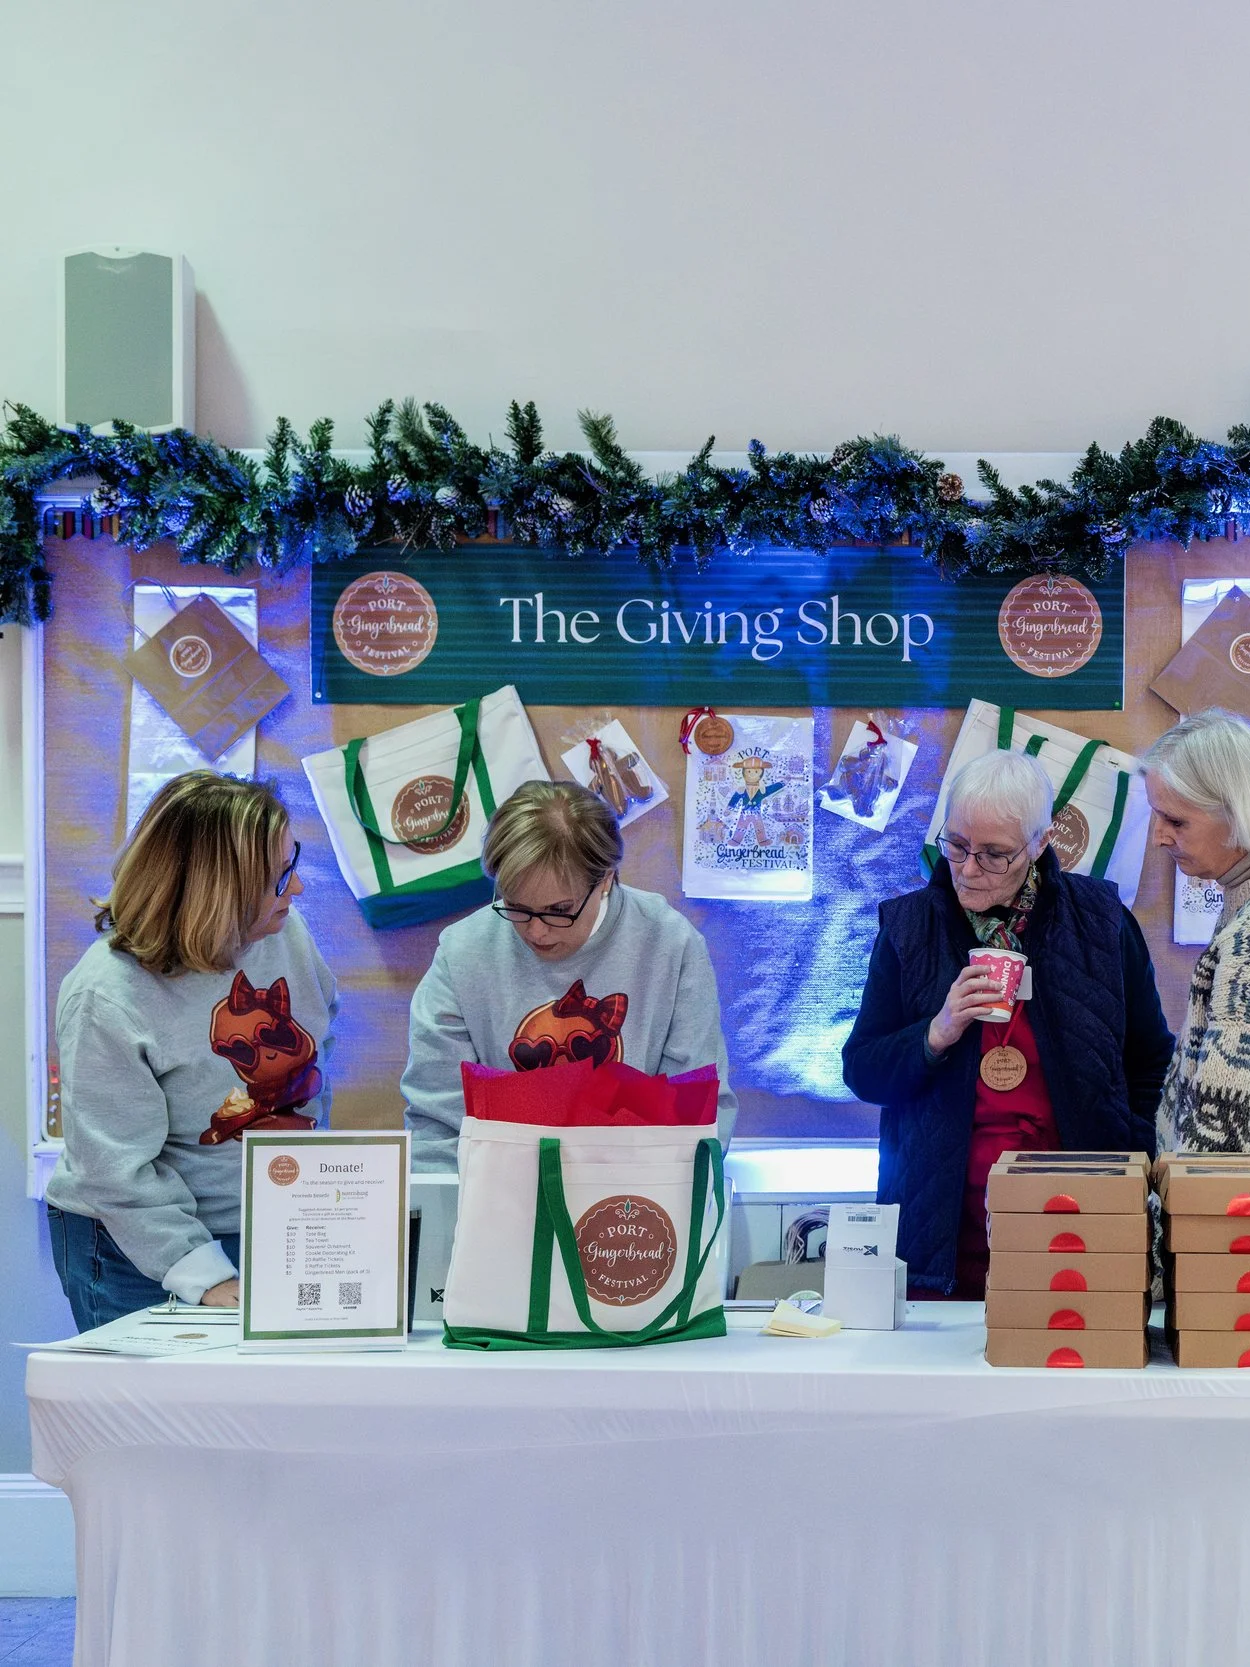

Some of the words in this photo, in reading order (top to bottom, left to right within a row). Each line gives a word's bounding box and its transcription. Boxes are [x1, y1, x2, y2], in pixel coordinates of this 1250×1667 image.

[368, 599, 407, 612] PORT
[1032, 600, 1071, 613] PORT
[346, 614, 425, 640] Gingerbread
[500, 592, 600, 644] The
[616, 598, 783, 662] Giving
[797, 594, 935, 662] Shop
[1011, 616, 1089, 642] Gingerbread
[361, 645, 411, 660] FESTIVAL
[1026, 646, 1075, 662] FESTIVAL
[737, 747, 770, 760] PORT
[414, 794, 443, 811] PORT
[1052, 820, 1072, 834] ORT
[716, 843, 787, 864] Gingerbread
[741, 858, 795, 869] FESTIVAL
[319, 1163, 364, 1173] Donate!
[607, 1224, 648, 1238] PORT
[583, 1241, 665, 1267] Gingerbread
[597, 1273, 649, 1290] FESTIVAL
